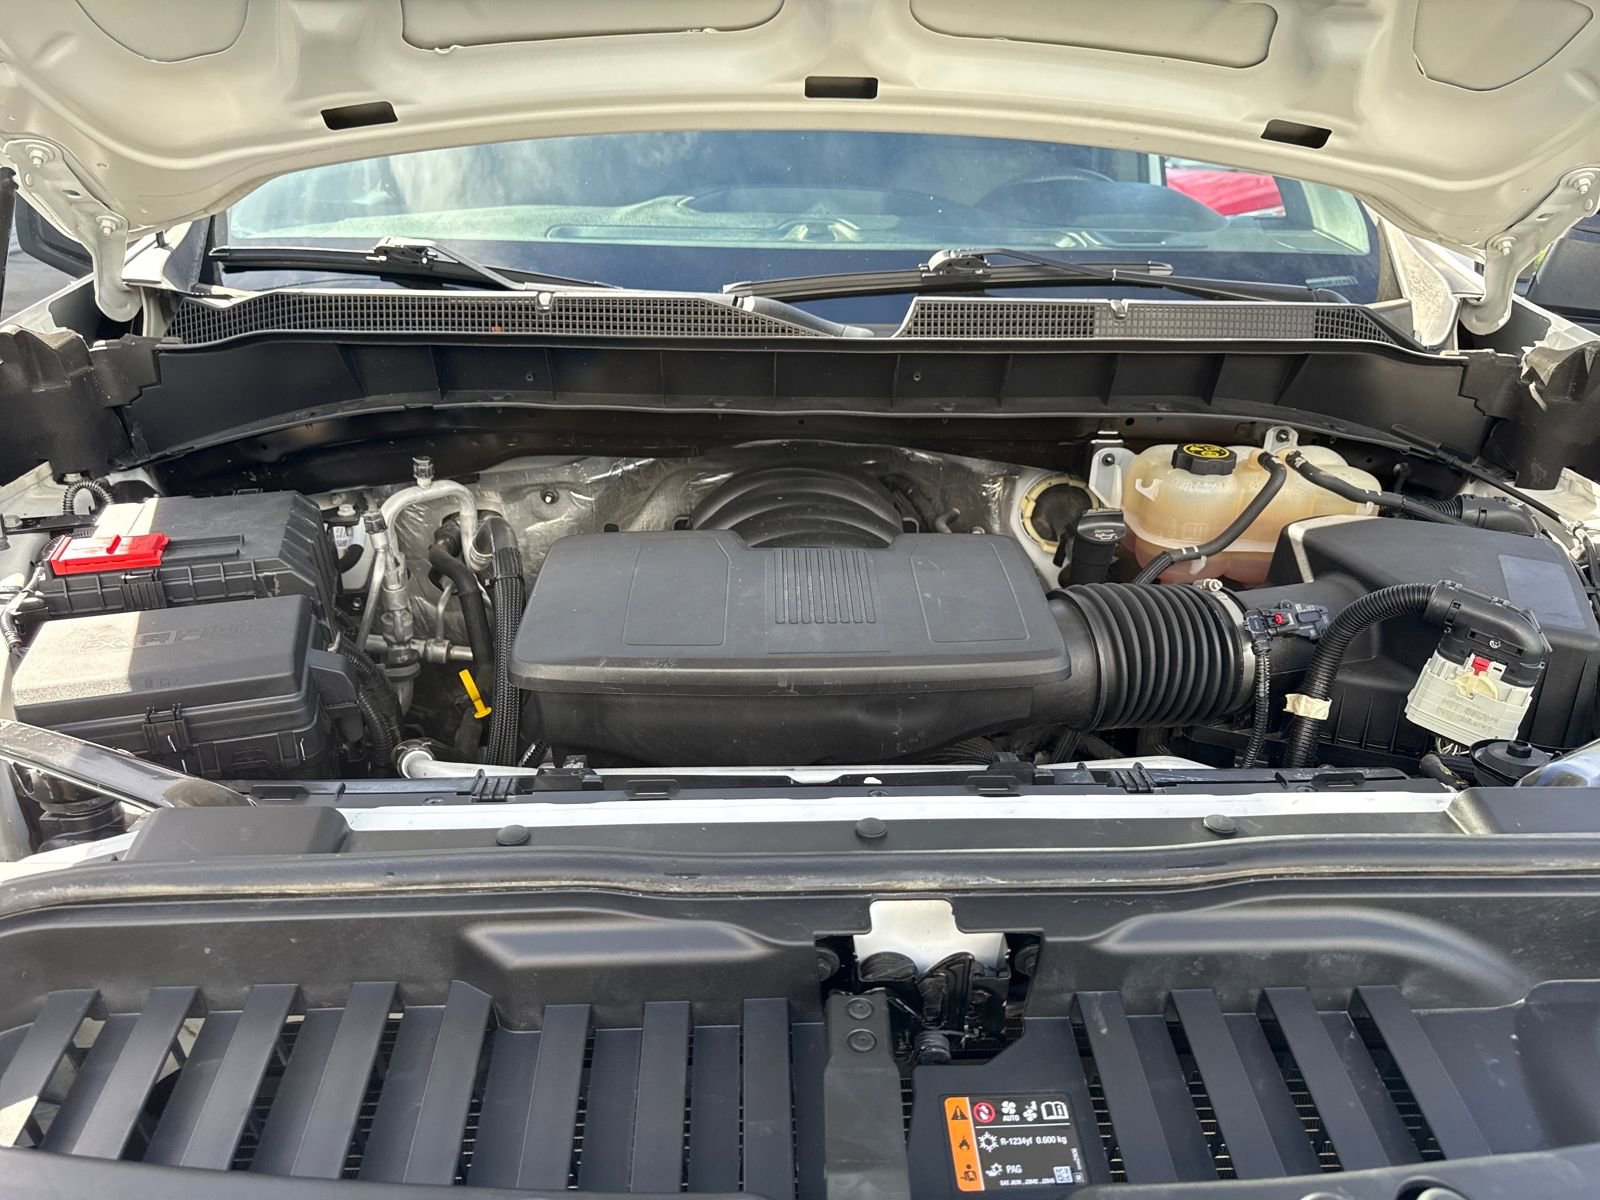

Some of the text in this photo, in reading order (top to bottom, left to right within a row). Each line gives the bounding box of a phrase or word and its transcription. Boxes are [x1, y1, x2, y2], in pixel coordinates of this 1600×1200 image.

[1000, 1136, 1068, 1146] R-1234yf 0.600 kg
[1006, 1165, 1022, 1174] PAG
